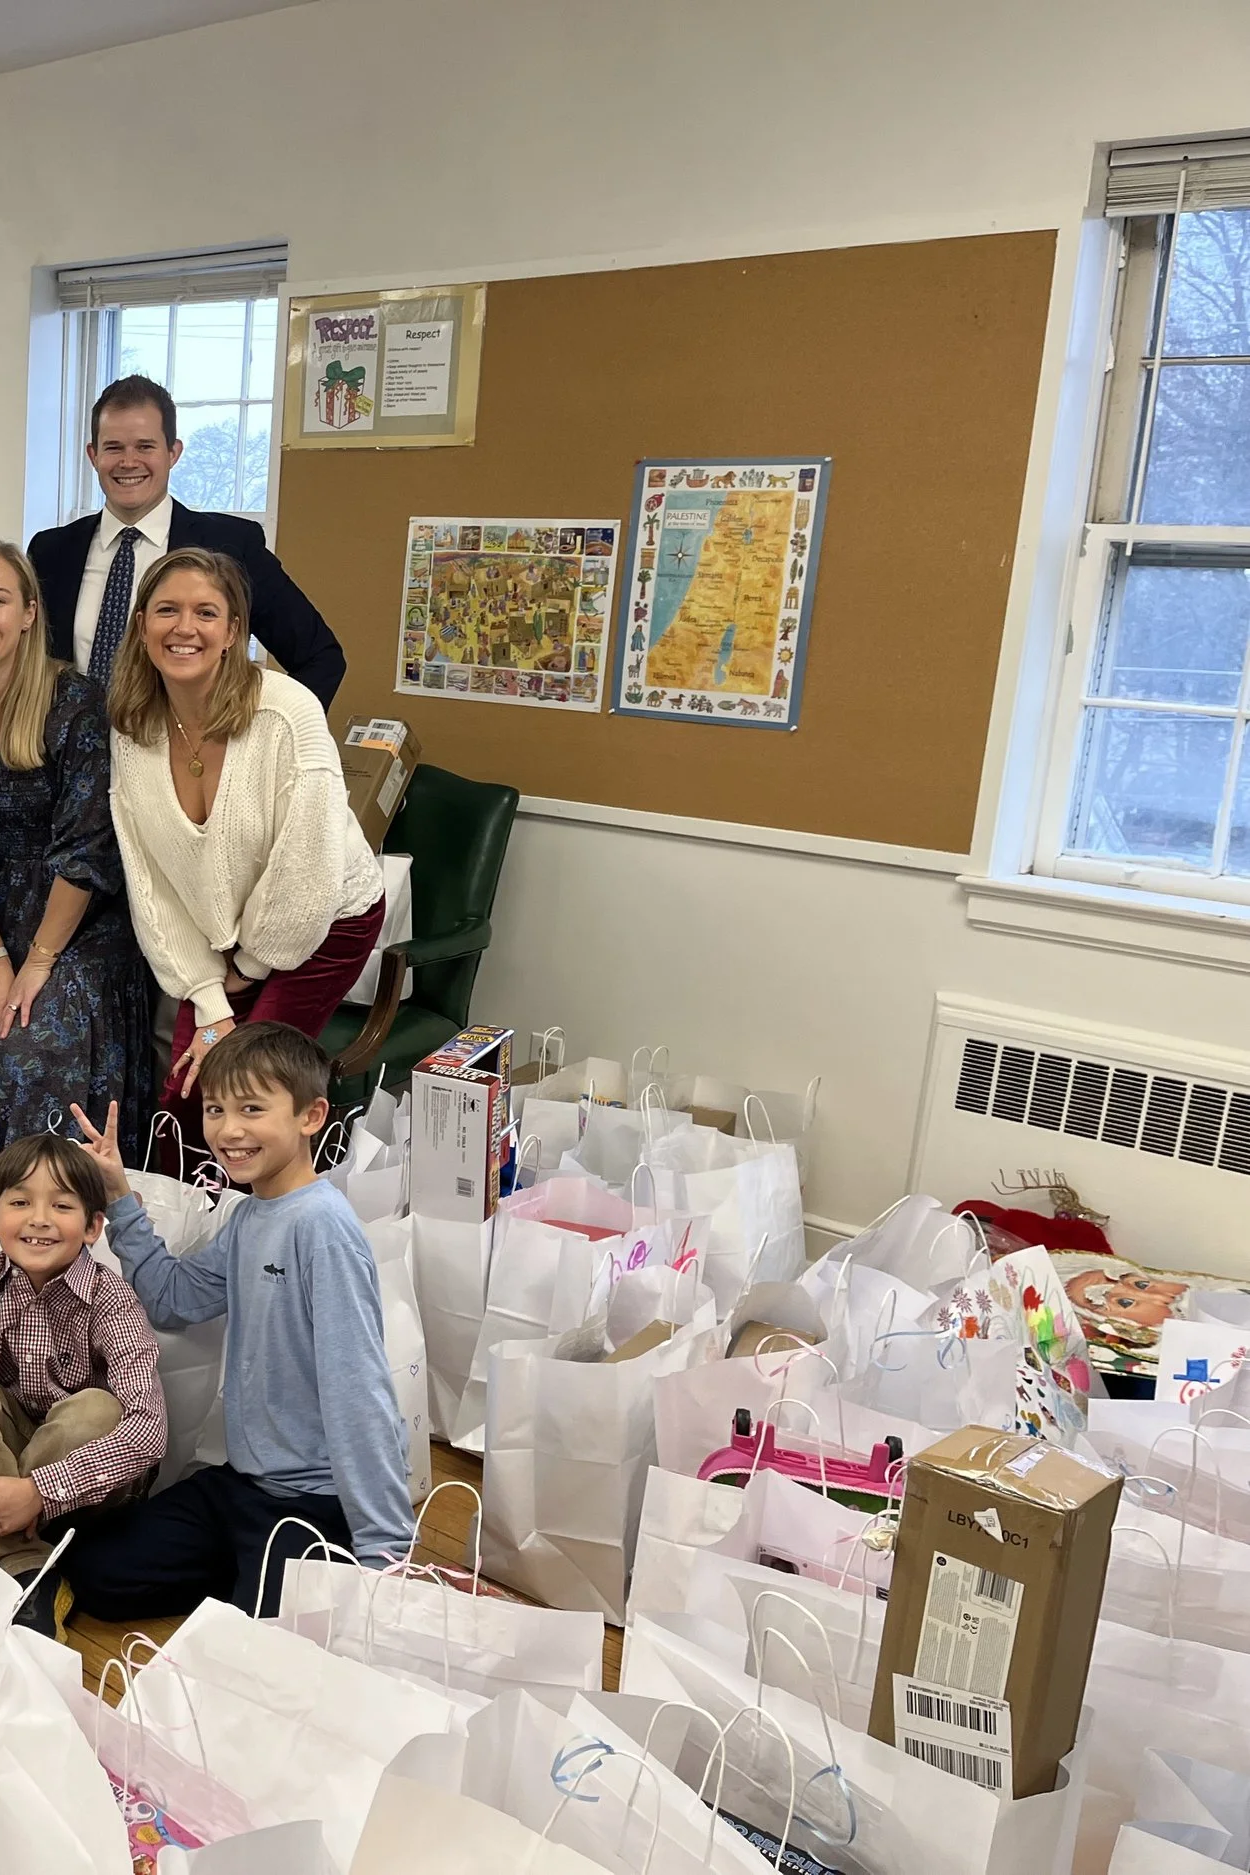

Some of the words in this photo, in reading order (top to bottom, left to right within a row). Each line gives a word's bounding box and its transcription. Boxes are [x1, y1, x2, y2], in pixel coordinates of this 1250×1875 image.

[406, 328, 440, 341] Respect
[666, 512, 709, 520] PALESTINE
[429, 1068, 478, 1081] TRUCKS
[947, 1510, 1029, 1549] LBY0C1
[748, 1832, 822, 1875] RESCUE
